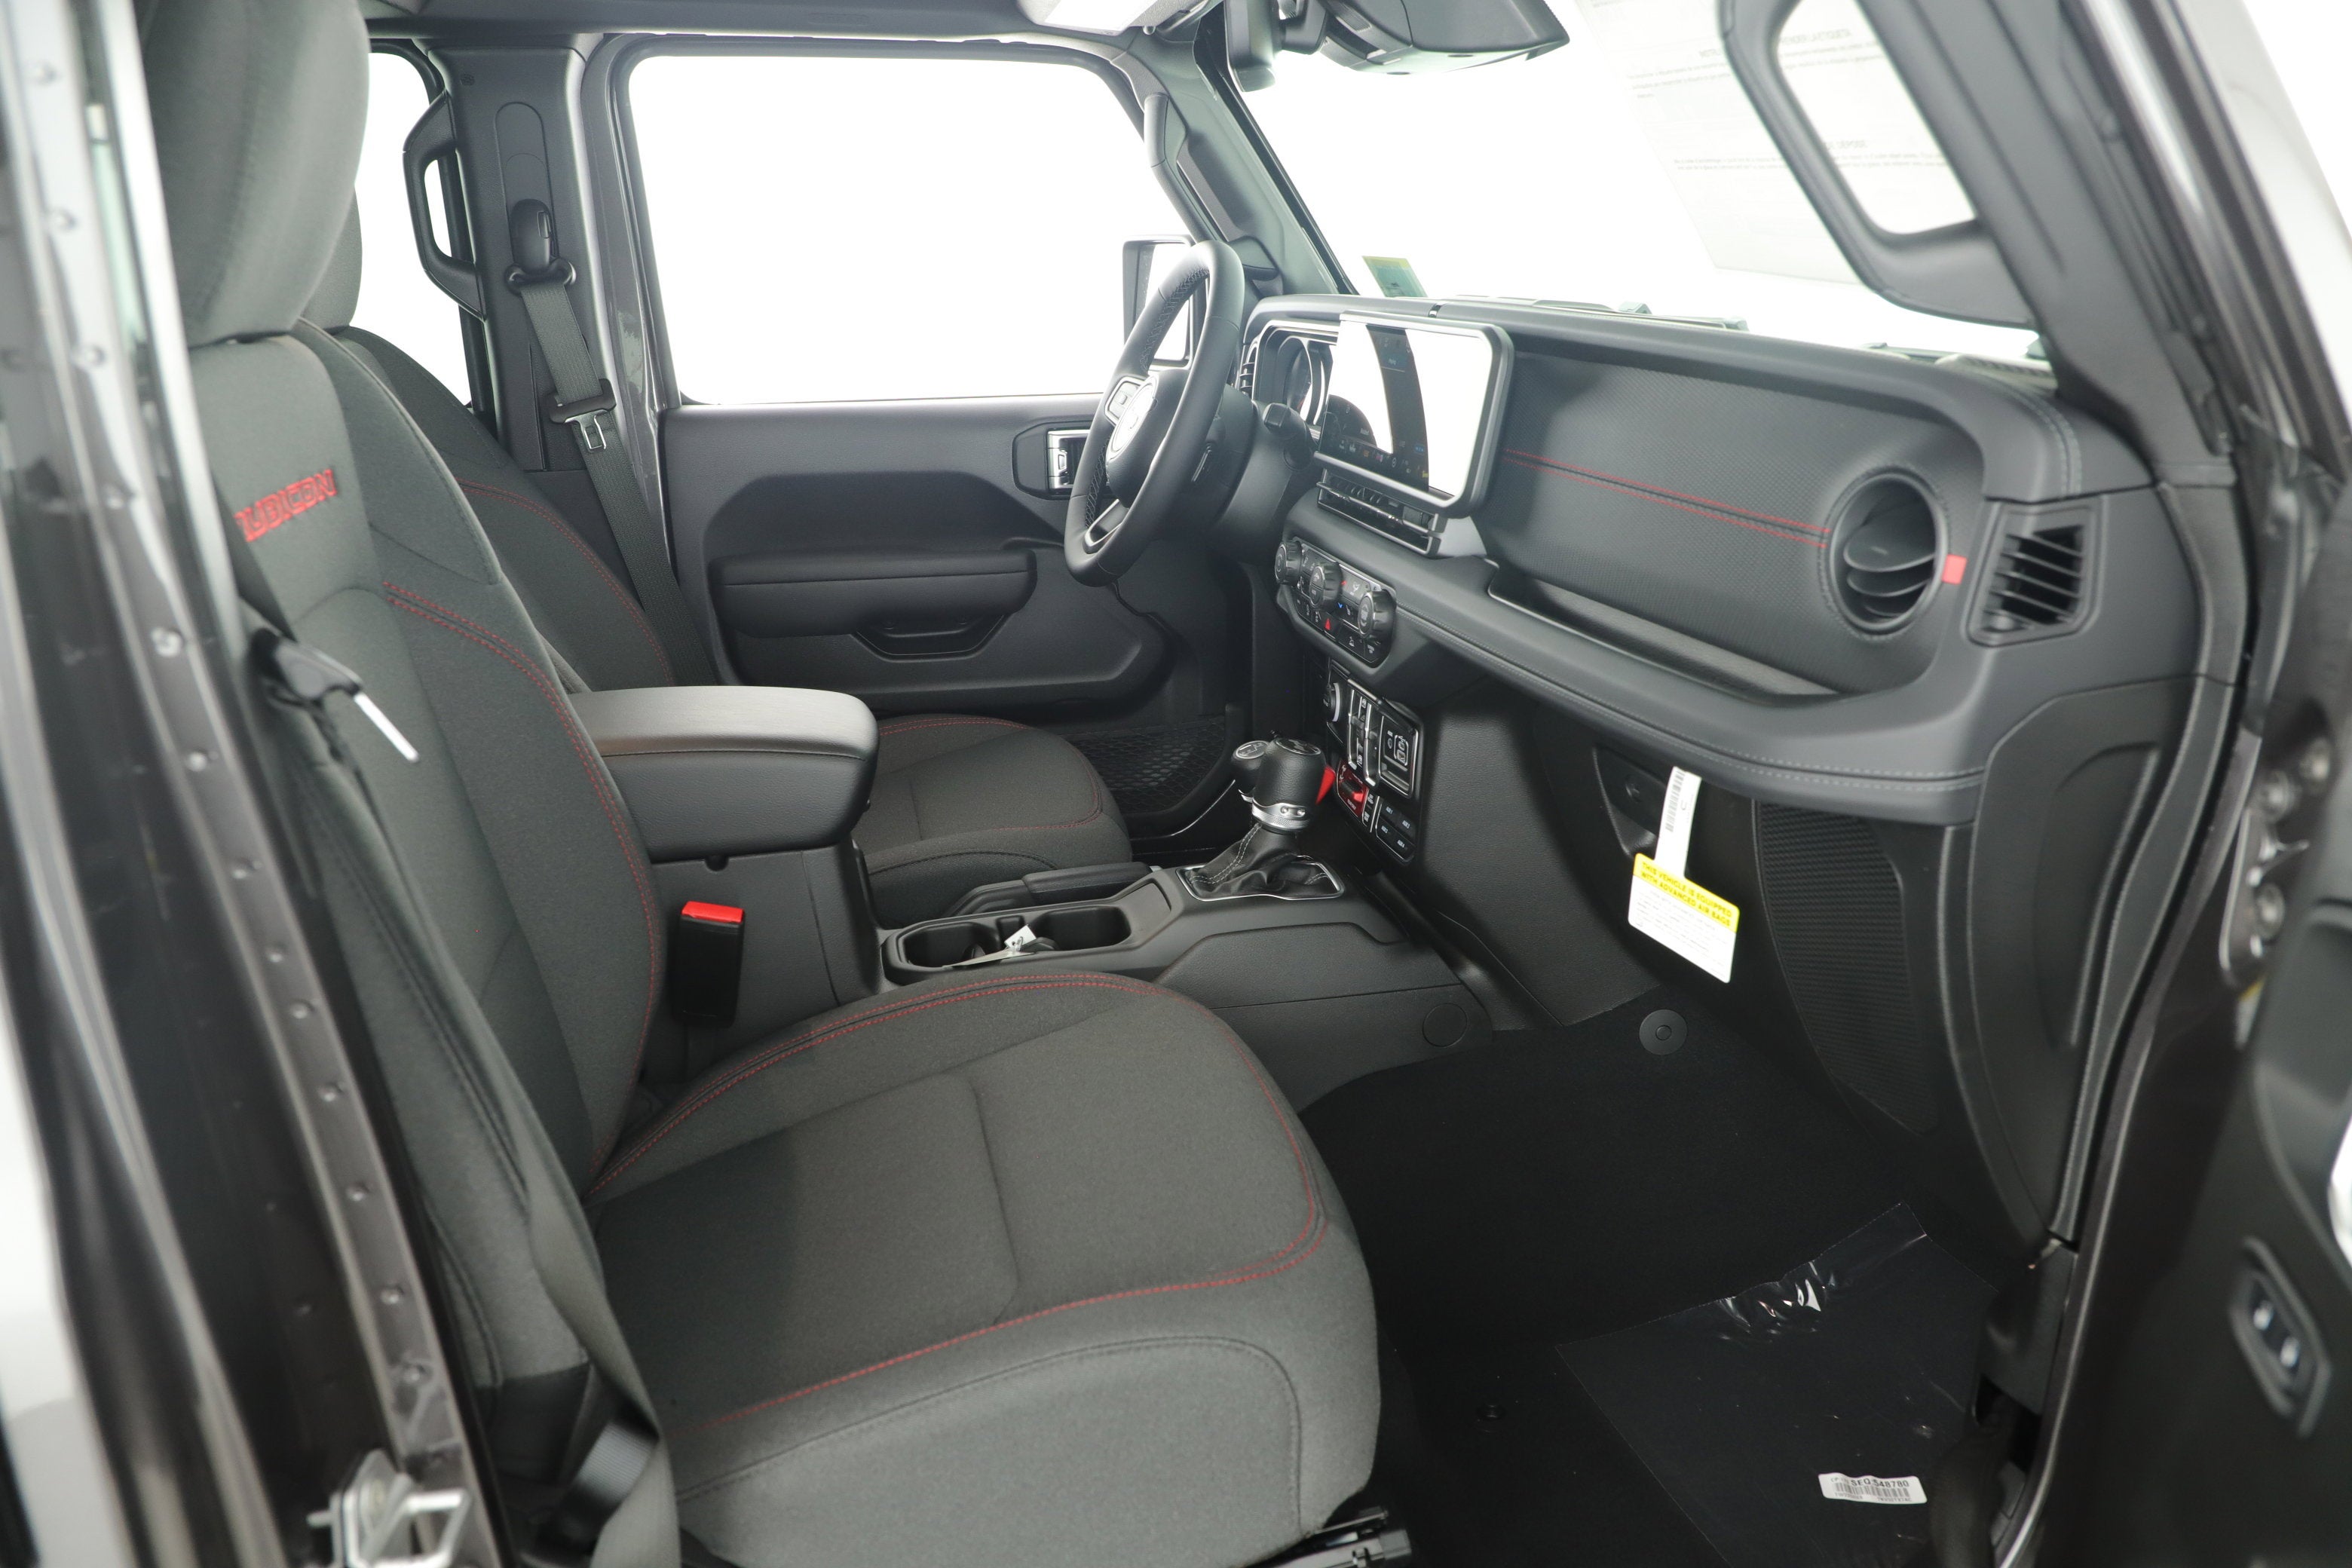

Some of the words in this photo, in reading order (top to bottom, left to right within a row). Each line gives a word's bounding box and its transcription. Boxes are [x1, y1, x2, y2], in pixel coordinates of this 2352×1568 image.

[1640, 871, 1658, 885] WITH
[1659, 881, 1697, 907] ADVANCED
[1698, 902, 1710, 914] AIR
[1711, 911, 1731, 927] BAGS
[1642, 862, 1657, 876] THIS
[1658, 872, 1686, 891] VEHICLE
[1688, 888, 1695, 897] IS
[1696, 893, 1732, 918] EQUIPPED
